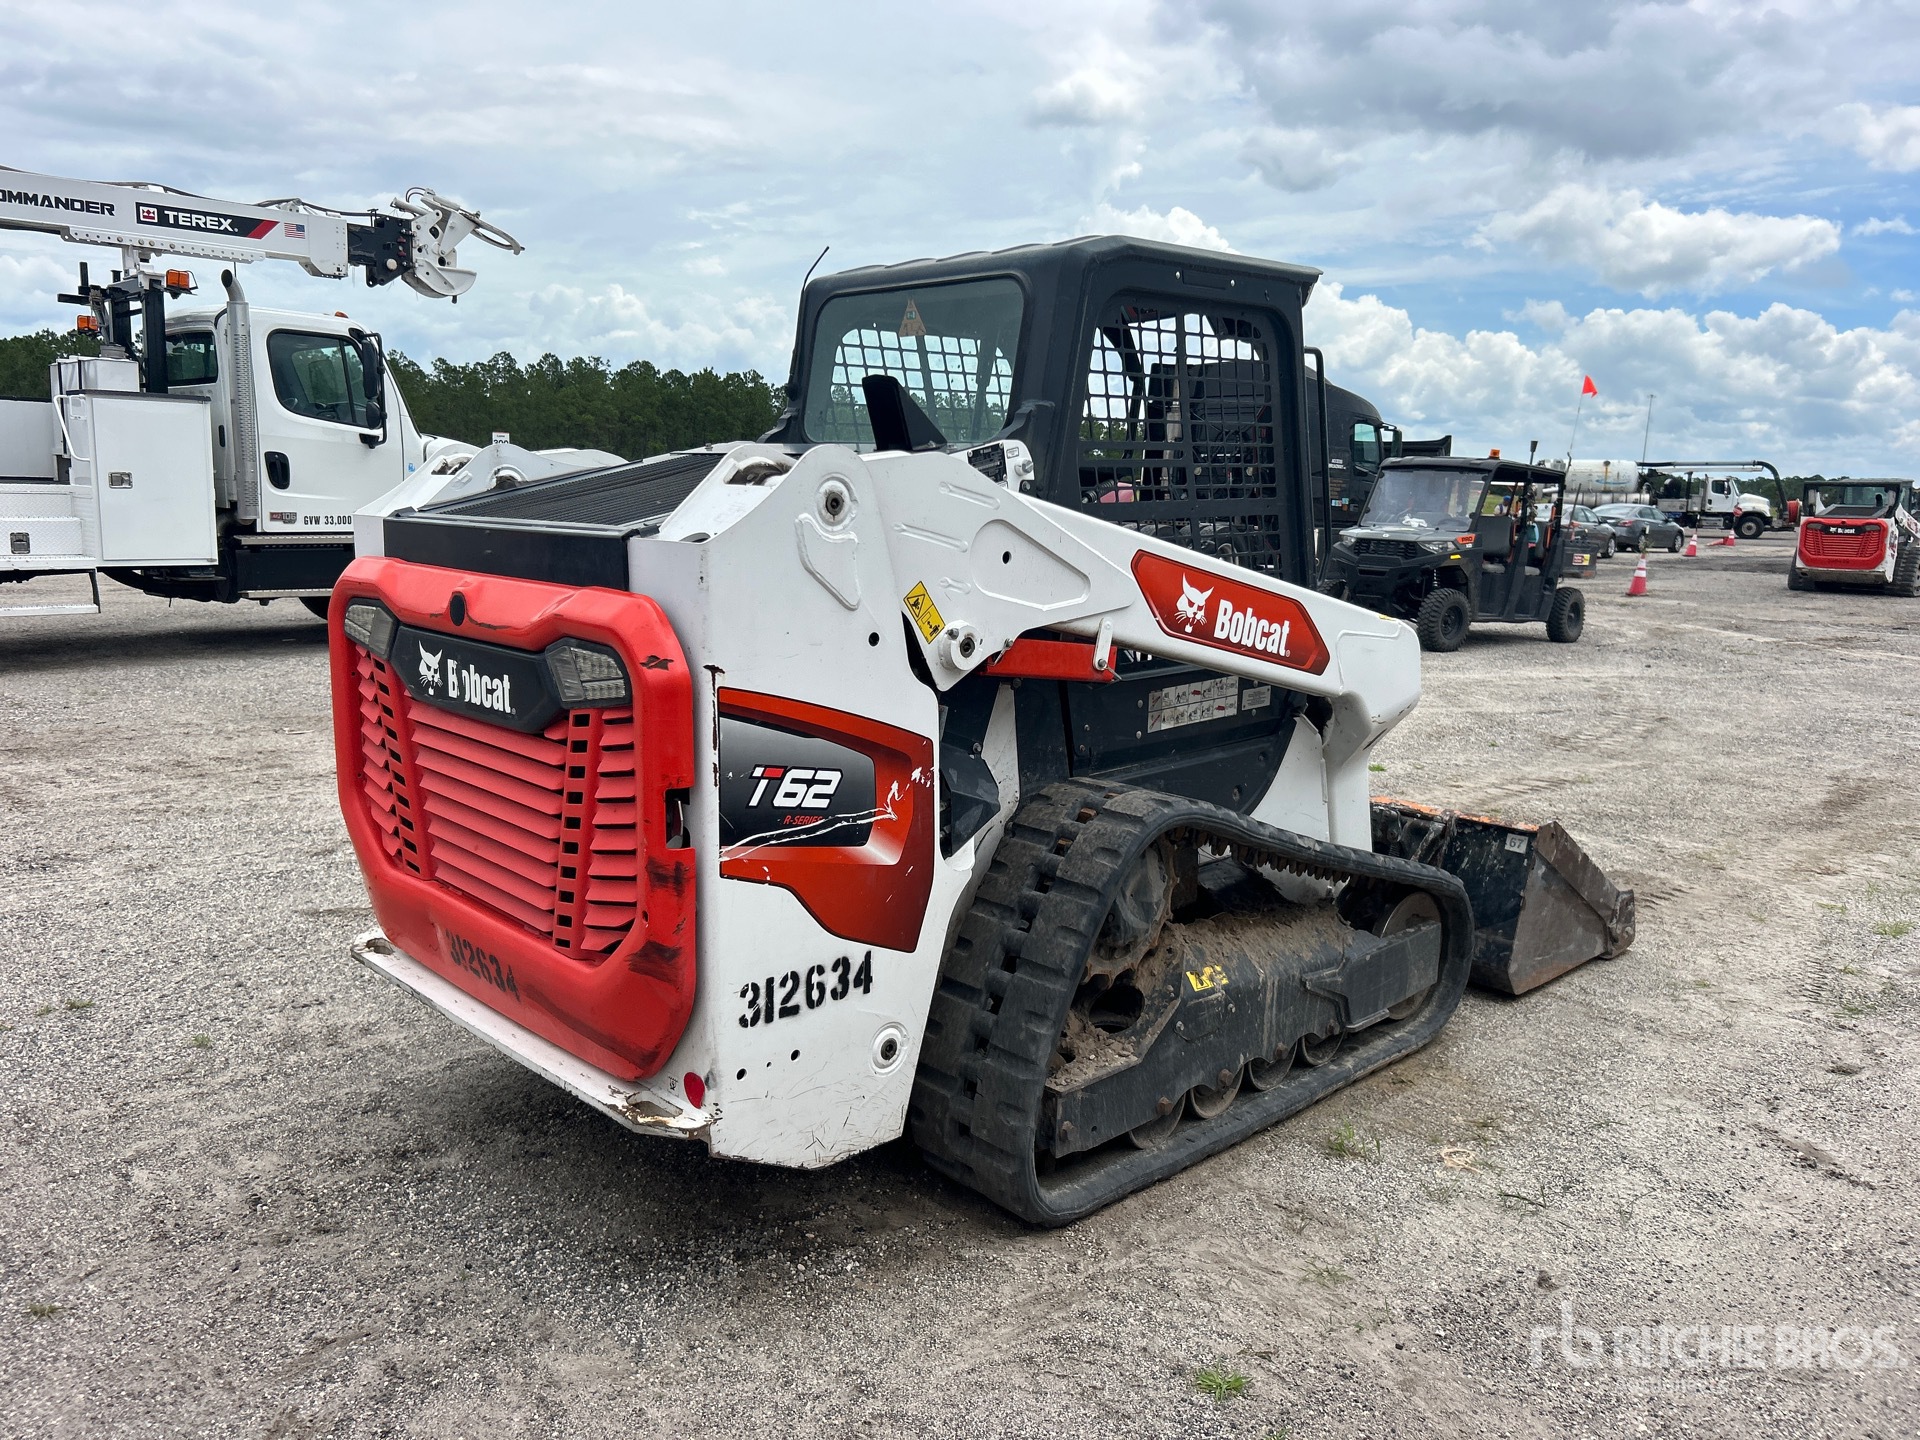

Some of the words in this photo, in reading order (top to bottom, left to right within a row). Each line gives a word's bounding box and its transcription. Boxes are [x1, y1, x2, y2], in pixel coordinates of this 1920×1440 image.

[164, 208, 234, 232] TEREX
[303, 515, 320, 525] GVW
[324, 515, 352, 526] 33,000
[1214, 598, 1290, 657] Bobcat
[747, 765, 842, 809] T62
[1509, 837, 1525, 849] 67
[738, 950, 873, 1028] 312634
